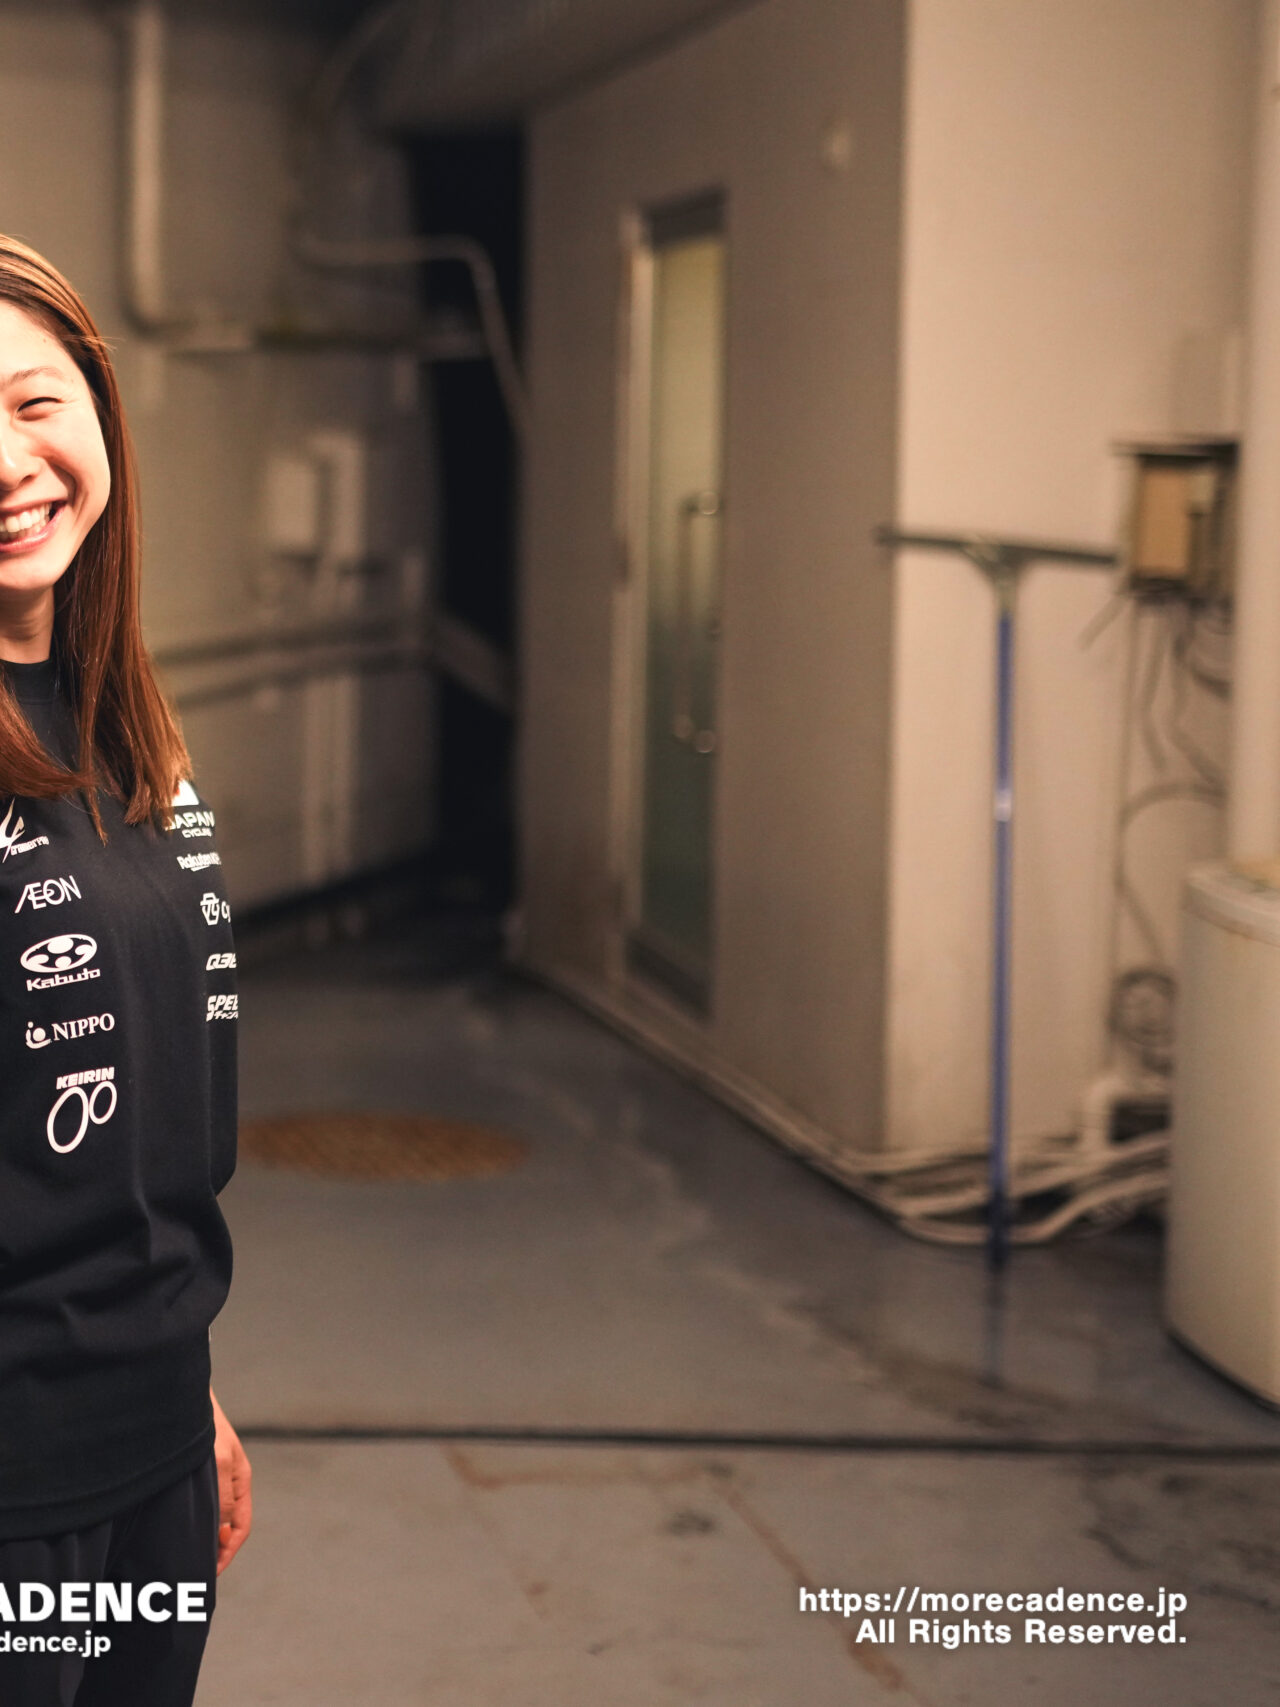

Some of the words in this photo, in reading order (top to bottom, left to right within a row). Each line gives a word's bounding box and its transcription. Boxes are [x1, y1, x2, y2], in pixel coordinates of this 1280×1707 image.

[26, 968, 101, 991] Kabuto
[52, 1014, 114, 1040] NIPPO
[56, 1066, 115, 1090] KEIRIN
